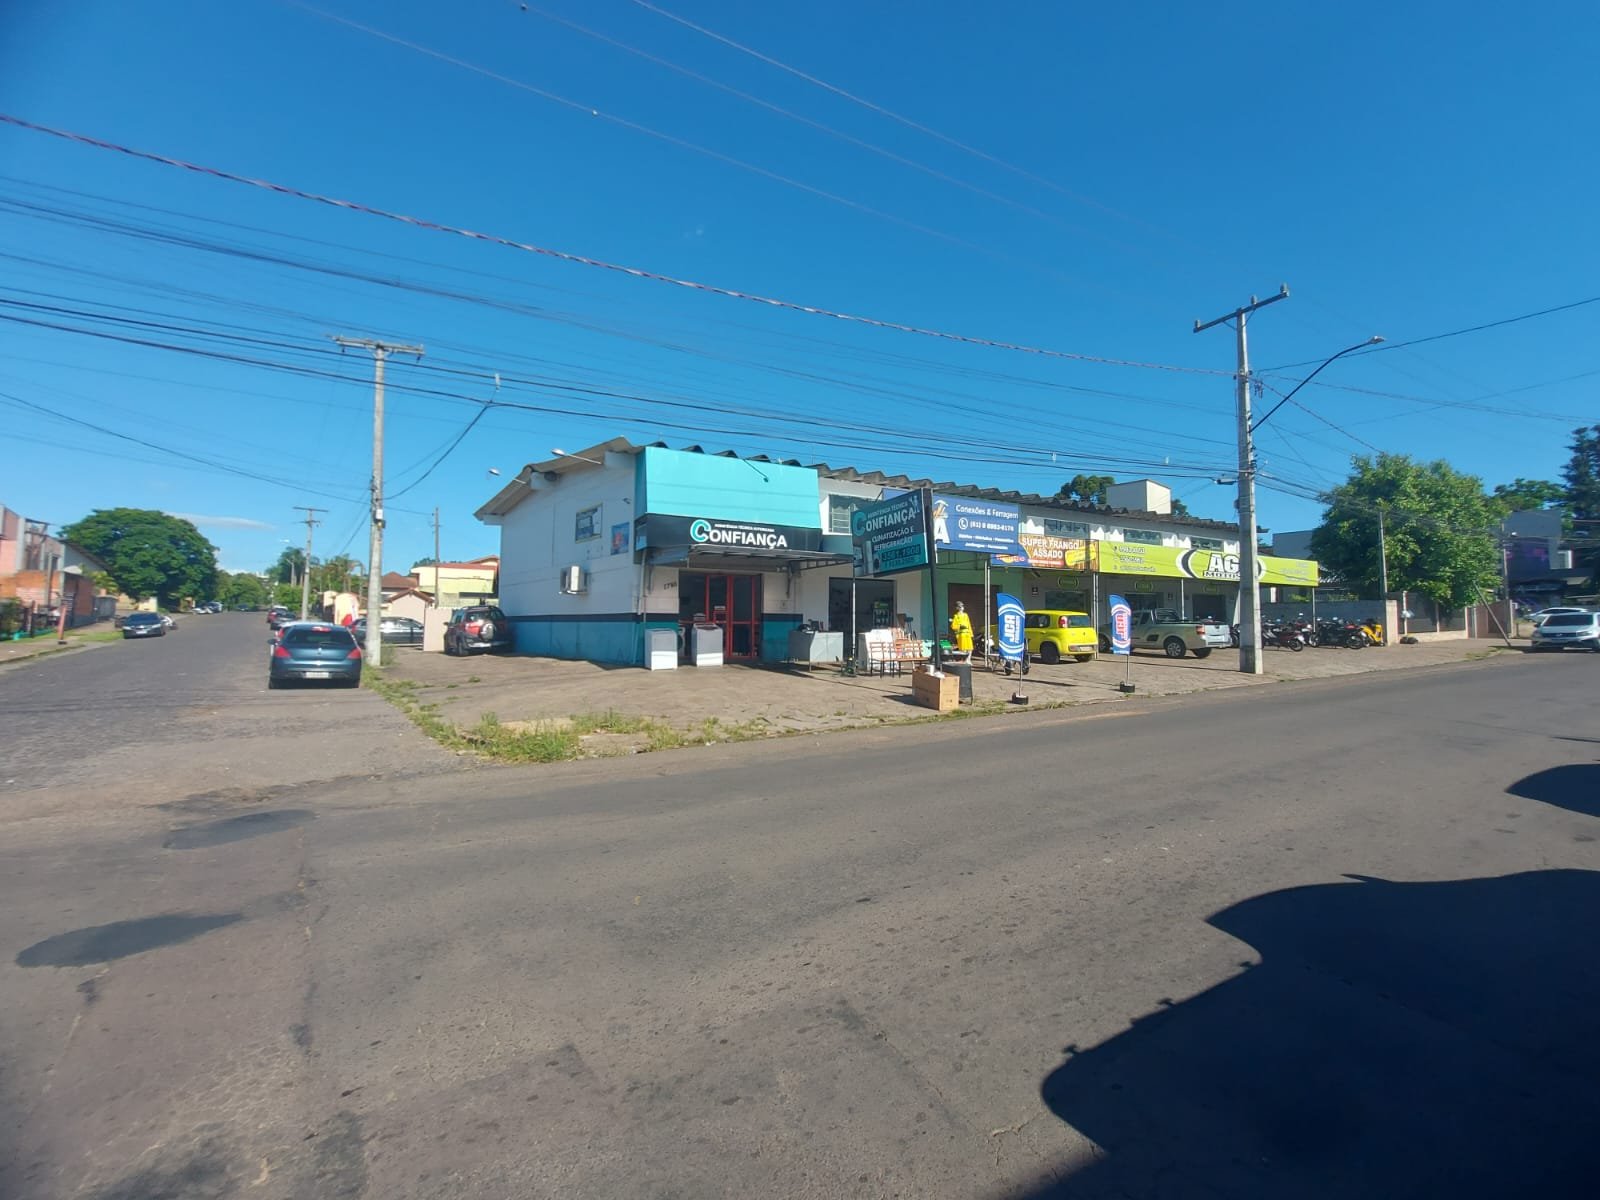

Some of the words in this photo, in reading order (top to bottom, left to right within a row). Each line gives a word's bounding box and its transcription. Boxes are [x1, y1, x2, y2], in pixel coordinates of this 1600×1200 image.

[956, 504, 985, 515] Conexões
[853, 507, 916, 537] CONFIANÇA
[690, 519, 788, 549] CONFIANÇA
[872, 527, 909, 543] CLIMATIZAÇÃO
[1023, 537, 1047, 548] SUPER
[1048, 538, 1079, 550] FRANGO
[1033, 547, 1063, 559] ASSADO
[1208, 553, 1240, 573] AG
